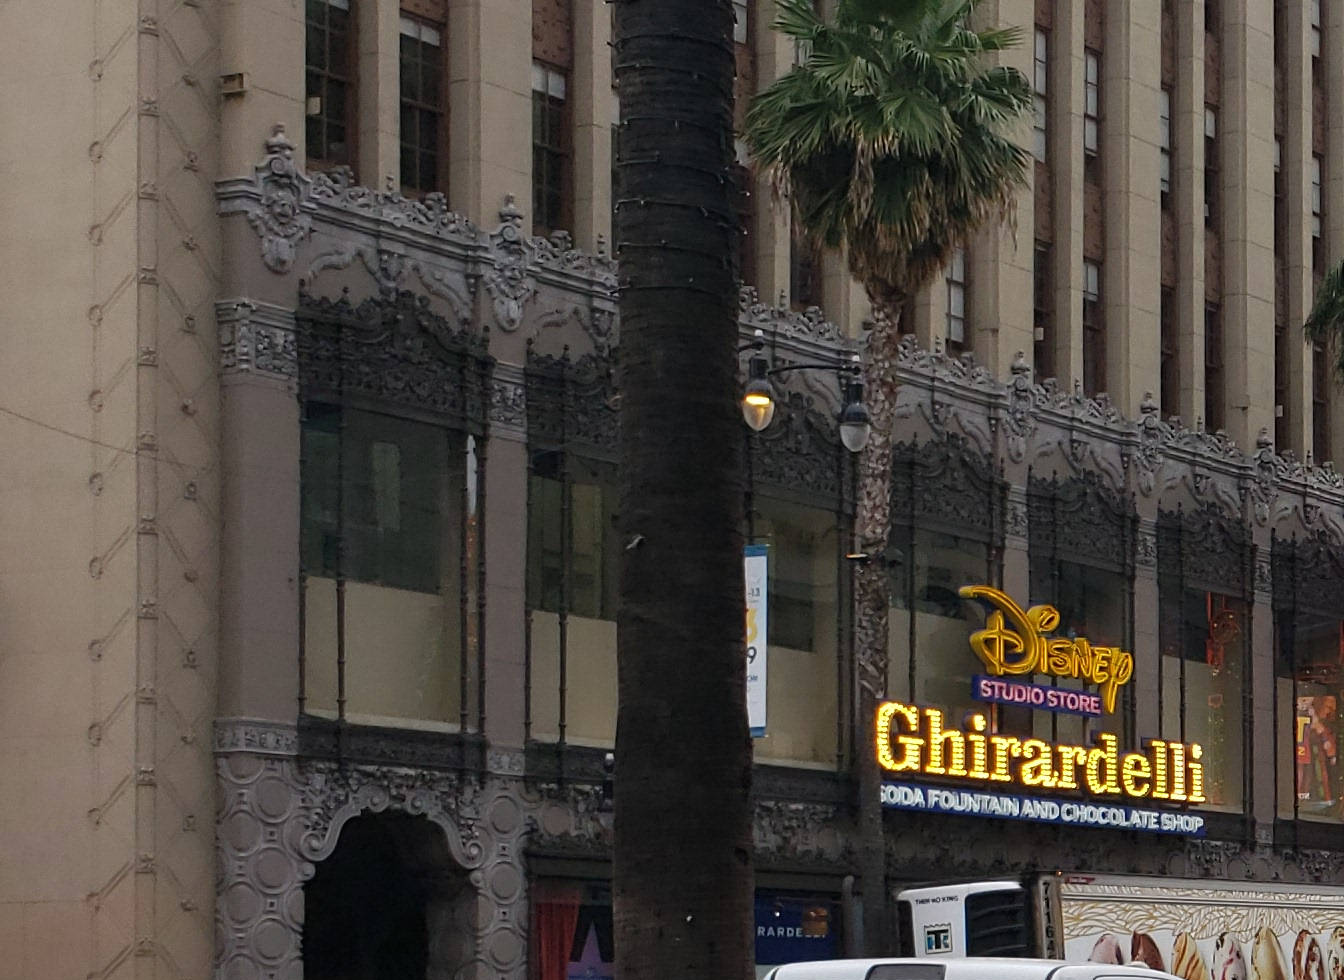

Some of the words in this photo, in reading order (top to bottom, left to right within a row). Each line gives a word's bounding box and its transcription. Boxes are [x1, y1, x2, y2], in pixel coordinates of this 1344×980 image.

[980, 679, 1045, 704] STUDIO
[1048, 689, 1100, 713] STORE
[875, 700, 1206, 803] Ghirardelli
[927, 788, 1021, 817] FOUNTAIN
[1021, 799, 1060, 820] AND
[1061, 802, 1159, 831] CHOCOLATE
[1161, 813, 1205, 834] SHOP
